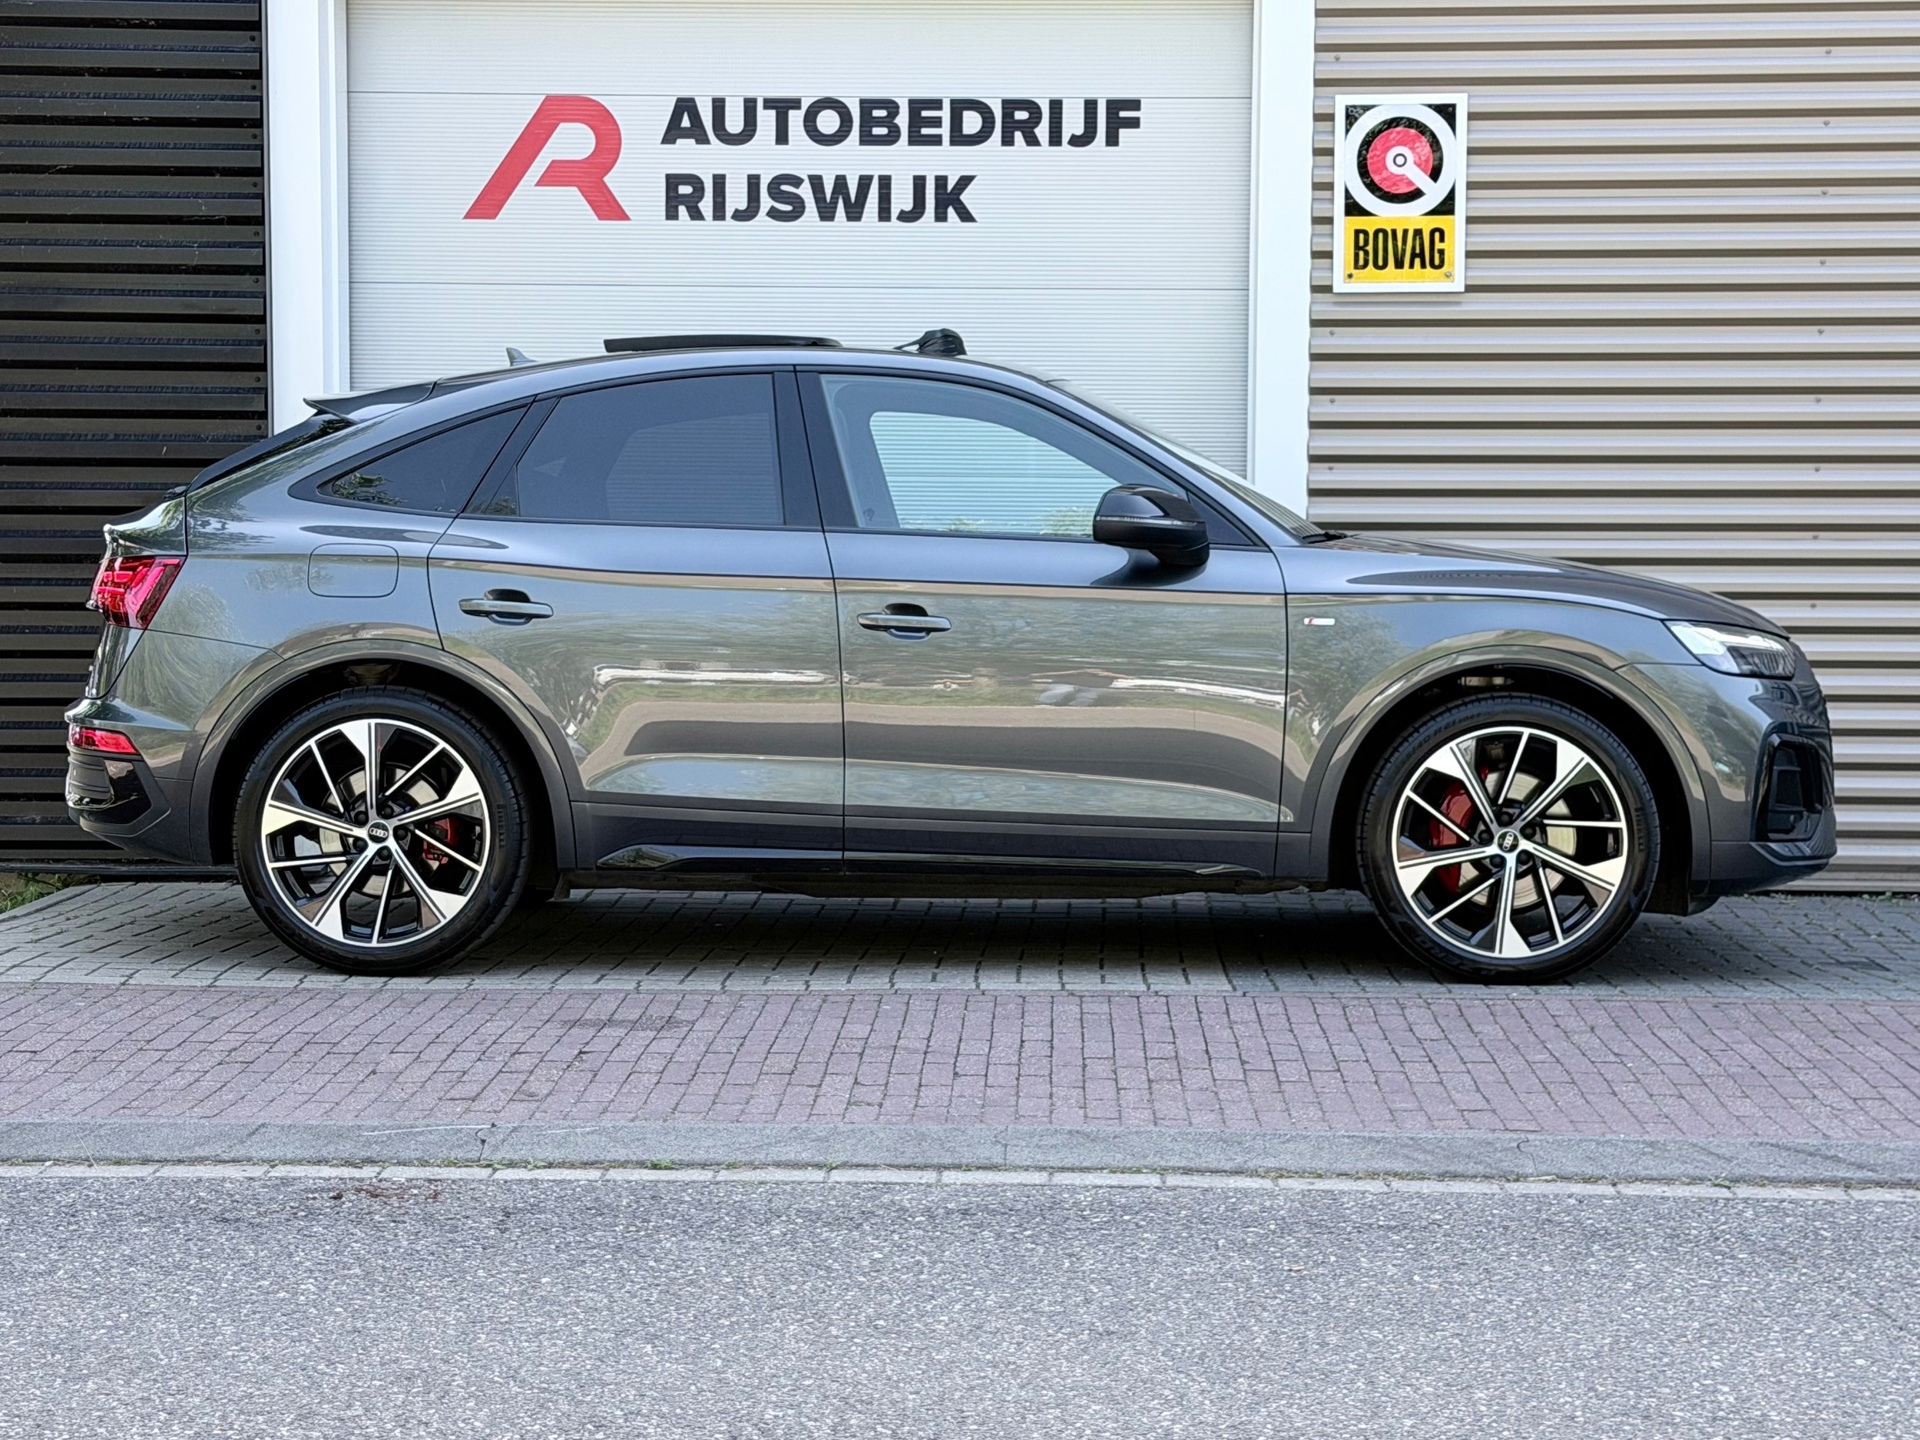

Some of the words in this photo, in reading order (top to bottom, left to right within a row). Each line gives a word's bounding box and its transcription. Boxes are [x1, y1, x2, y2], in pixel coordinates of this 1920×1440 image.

[661, 97, 1141, 147] AUTOBEDRIJF
[665, 173, 978, 223] RIJSWIJK
[1353, 227, 1446, 271] BOVAG
